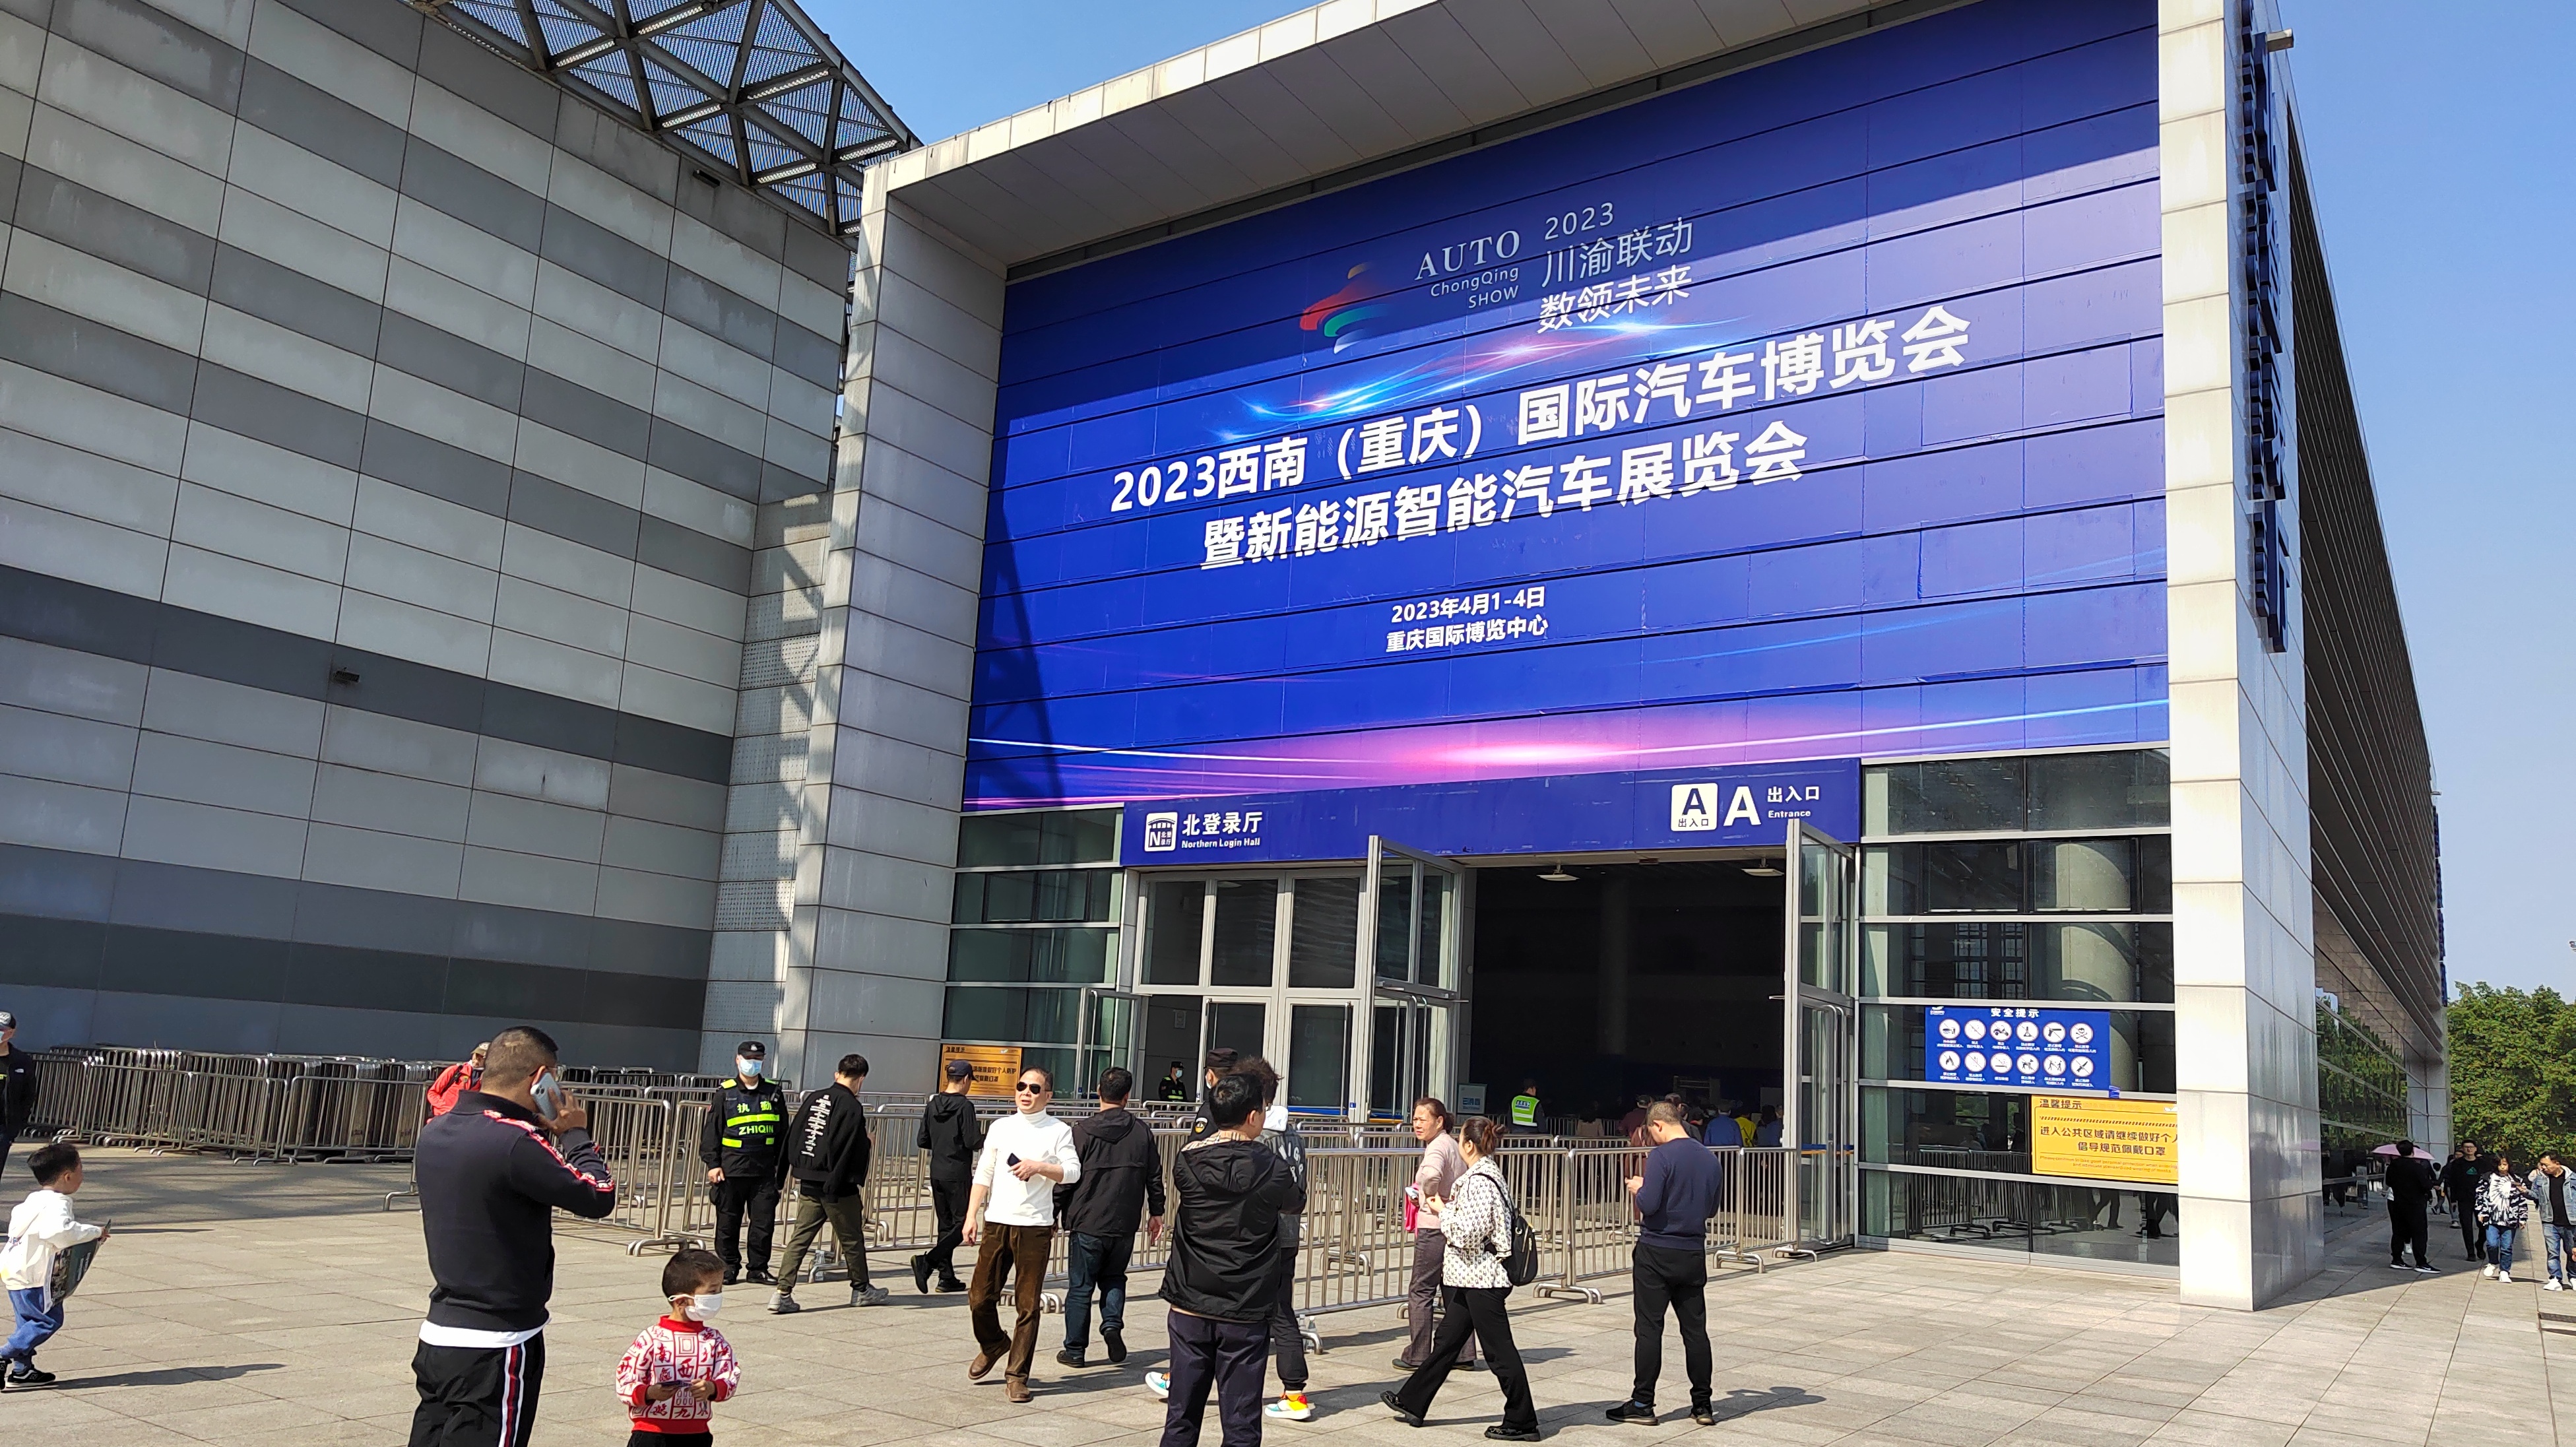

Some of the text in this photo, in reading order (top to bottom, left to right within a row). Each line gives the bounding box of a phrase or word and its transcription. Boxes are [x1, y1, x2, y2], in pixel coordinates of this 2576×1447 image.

[1545, 203, 1614, 240] 2023
[1415, 230, 1520, 280] AUTO
[1541, 216, 1692, 288] 川渝联动
[1430, 267, 1519, 297] ChongQing
[1468, 285, 1518, 309] SHOW
[1537, 265, 1692, 334] 数领未来
[1200, 420, 1808, 570] 暨新能源智能汽车展览会
[1391, 586, 1545, 623] 2023年4月1-4日
[1386, 614, 1549, 653] 重庆国际博览中心
[1682, 788, 1706, 816] A
[1723, 786, 1762, 826] A
[1767, 785, 1820, 803] 出入口
[1182, 812, 1263, 836] 北登录厅
[1678, 818, 1709, 827] 出入口
[1181, 837, 1260, 849] Northern Login Hall
[1991, 1008, 2040, 1019] 安全提示
